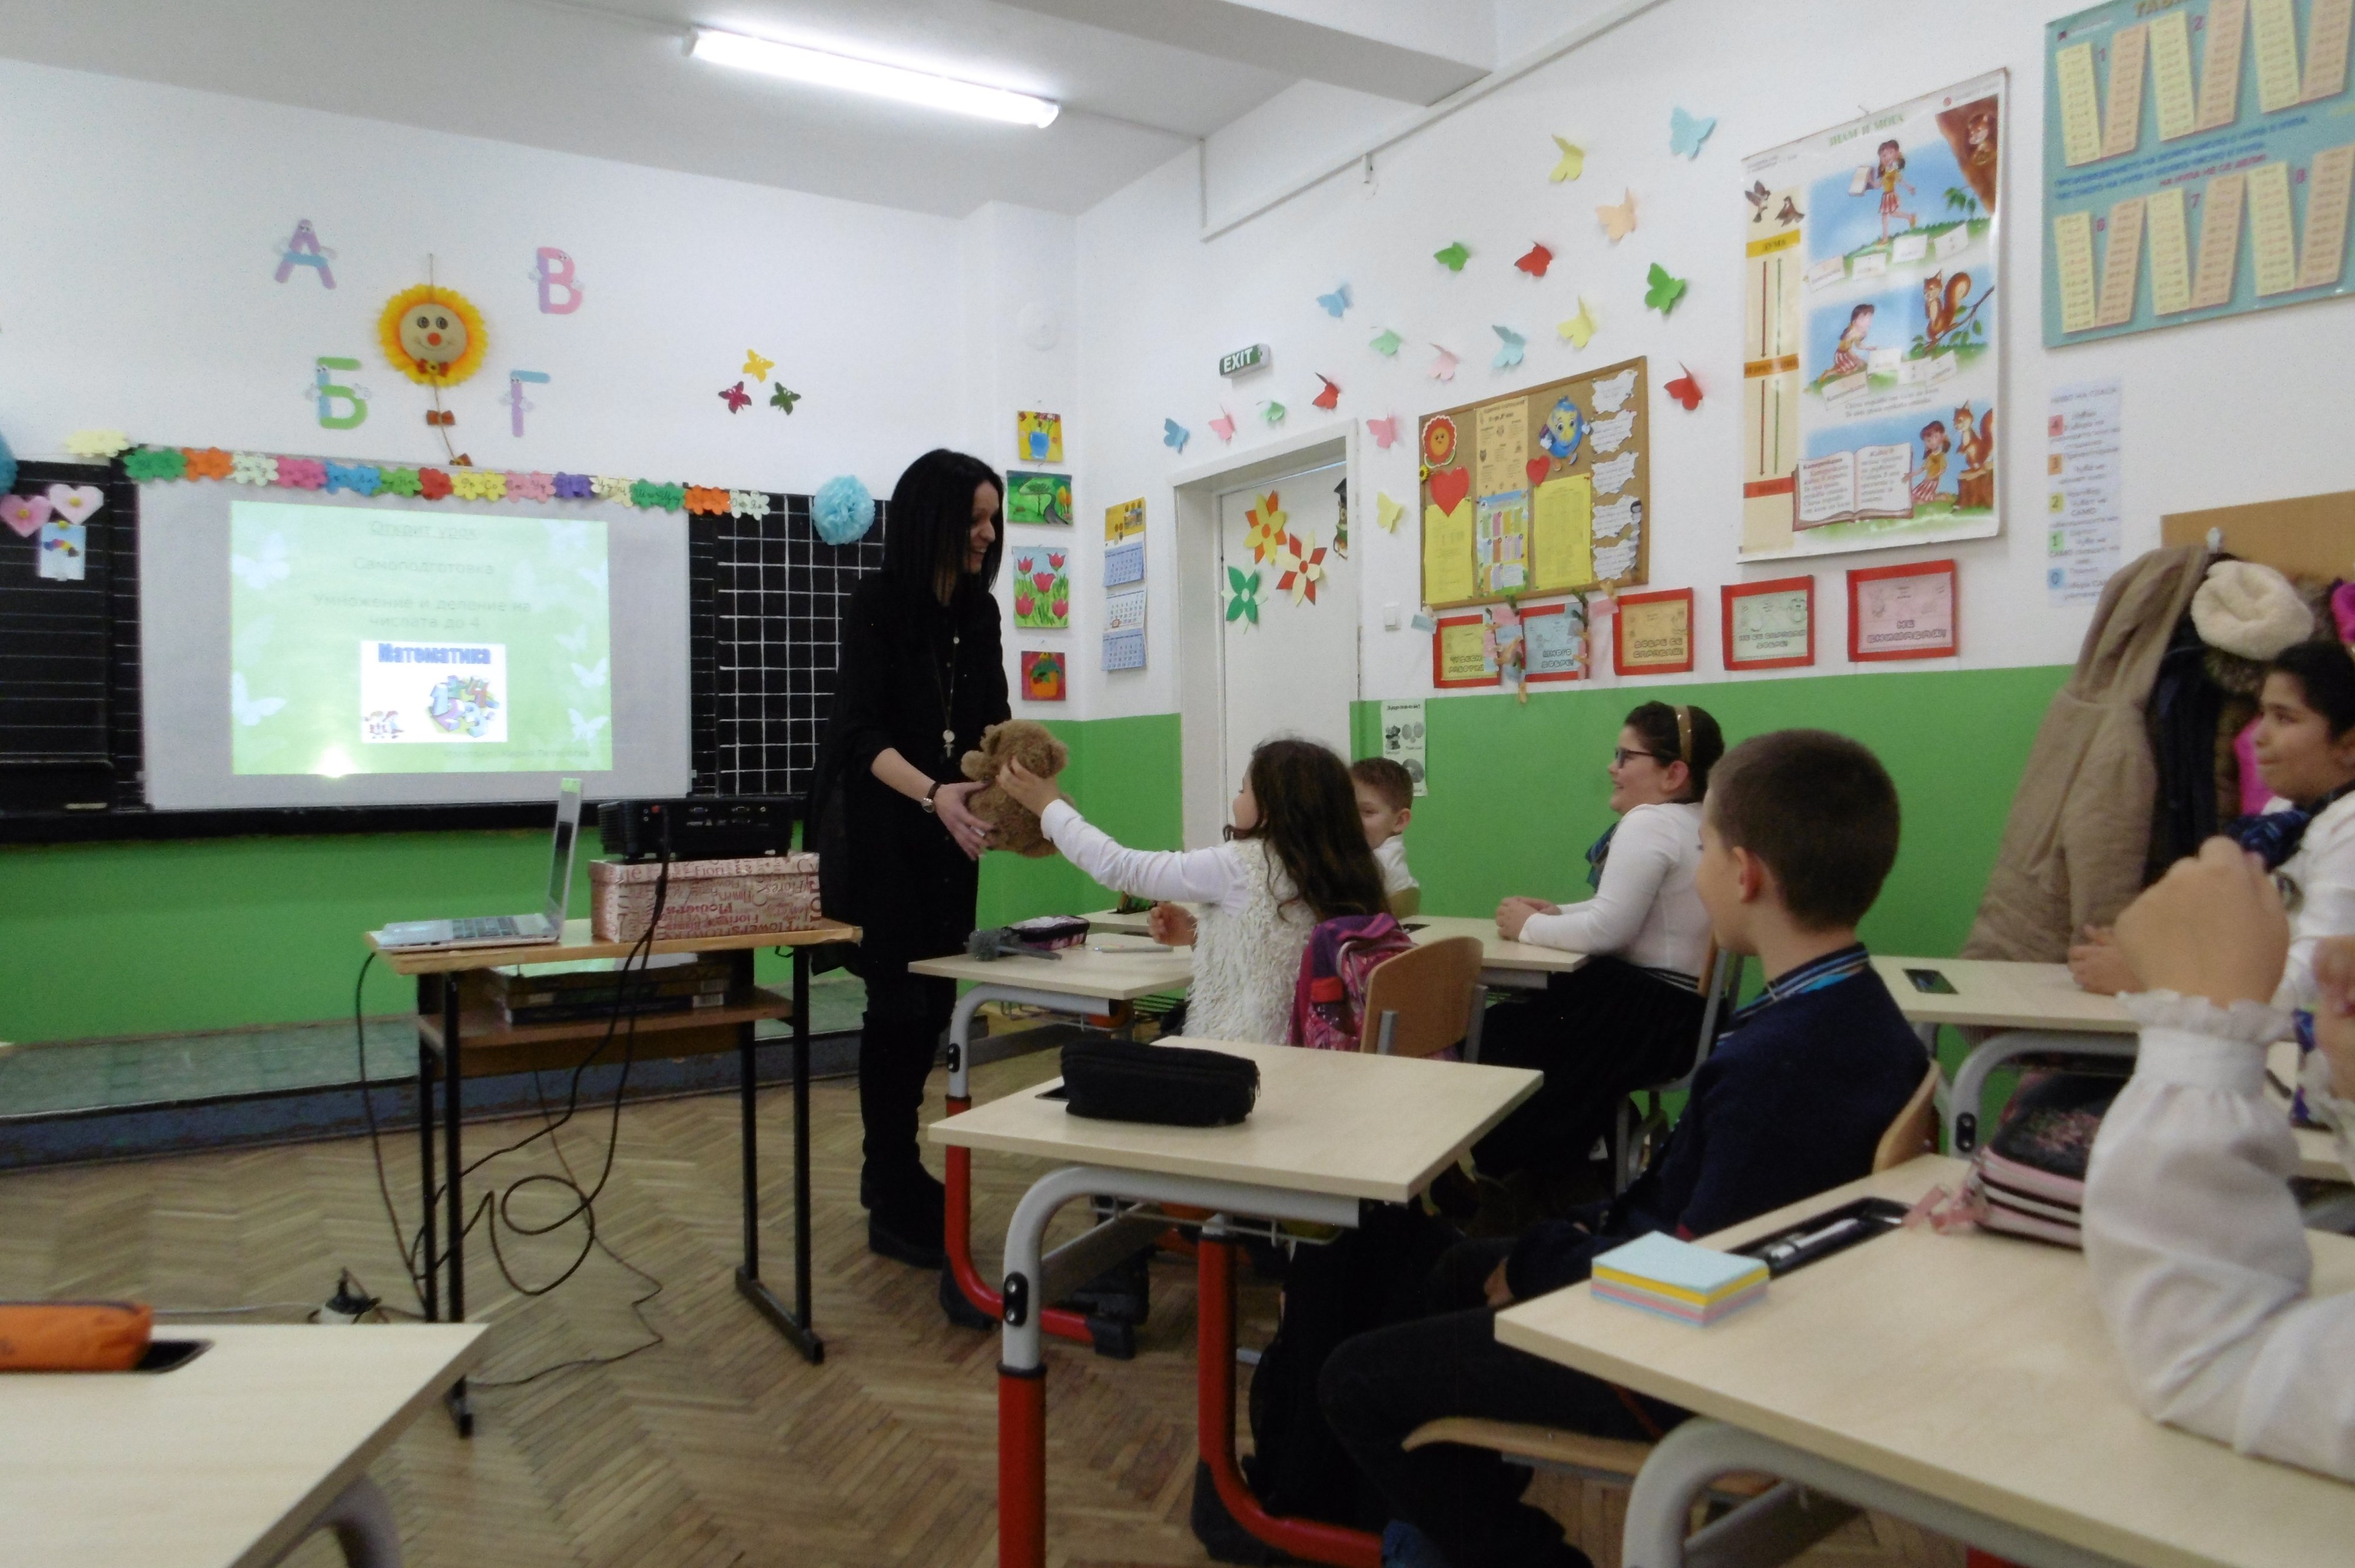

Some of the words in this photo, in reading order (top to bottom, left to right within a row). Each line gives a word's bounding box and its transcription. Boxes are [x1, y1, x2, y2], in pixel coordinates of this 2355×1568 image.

[1224, 347, 1253, 373] EXIT
[2052, 494, 2059, 509] 2
[369, 520, 433, 537] Открит
[438, 524, 478, 539] урок
[351, 556, 496, 575] Самоподготовка
[2051, 572, 2059, 585] 0
[313, 593, 413, 609] Умножение
[419, 599, 430, 609] и
[436, 599, 506, 612] деление
[510, 602, 532, 612] на
[370, 616, 439, 629] числата
[443, 619, 465, 630] до
[469, 616, 481, 629] 4
[378, 643, 491, 665] Математика
